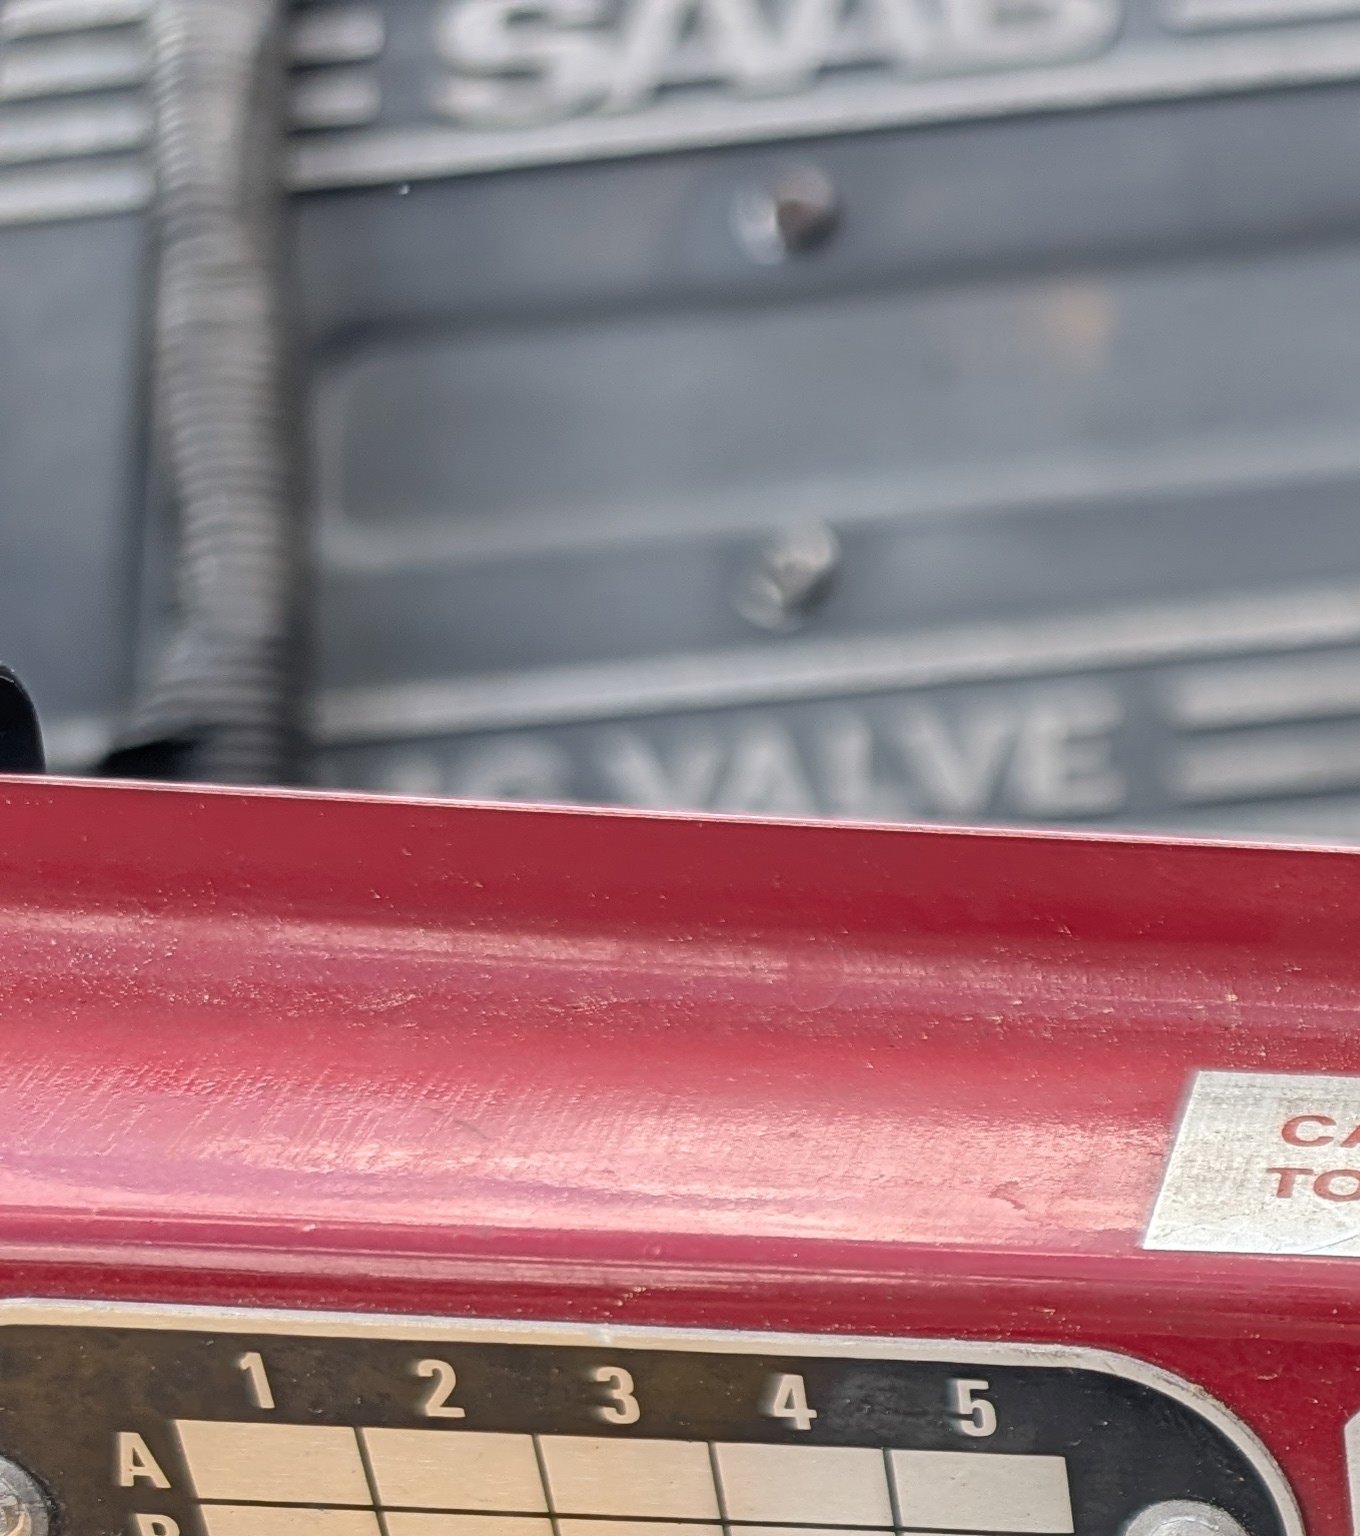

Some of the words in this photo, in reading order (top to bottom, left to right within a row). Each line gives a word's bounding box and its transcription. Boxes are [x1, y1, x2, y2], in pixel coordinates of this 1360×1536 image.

[238, 1352, 274, 1408] 1
[415, 1359, 465, 1417] 2
[594, 1367, 640, 1424] 3
[769, 1374, 817, 1430] 4
[955, 1379, 996, 1436] 5
[118, 1432, 171, 1488] A
